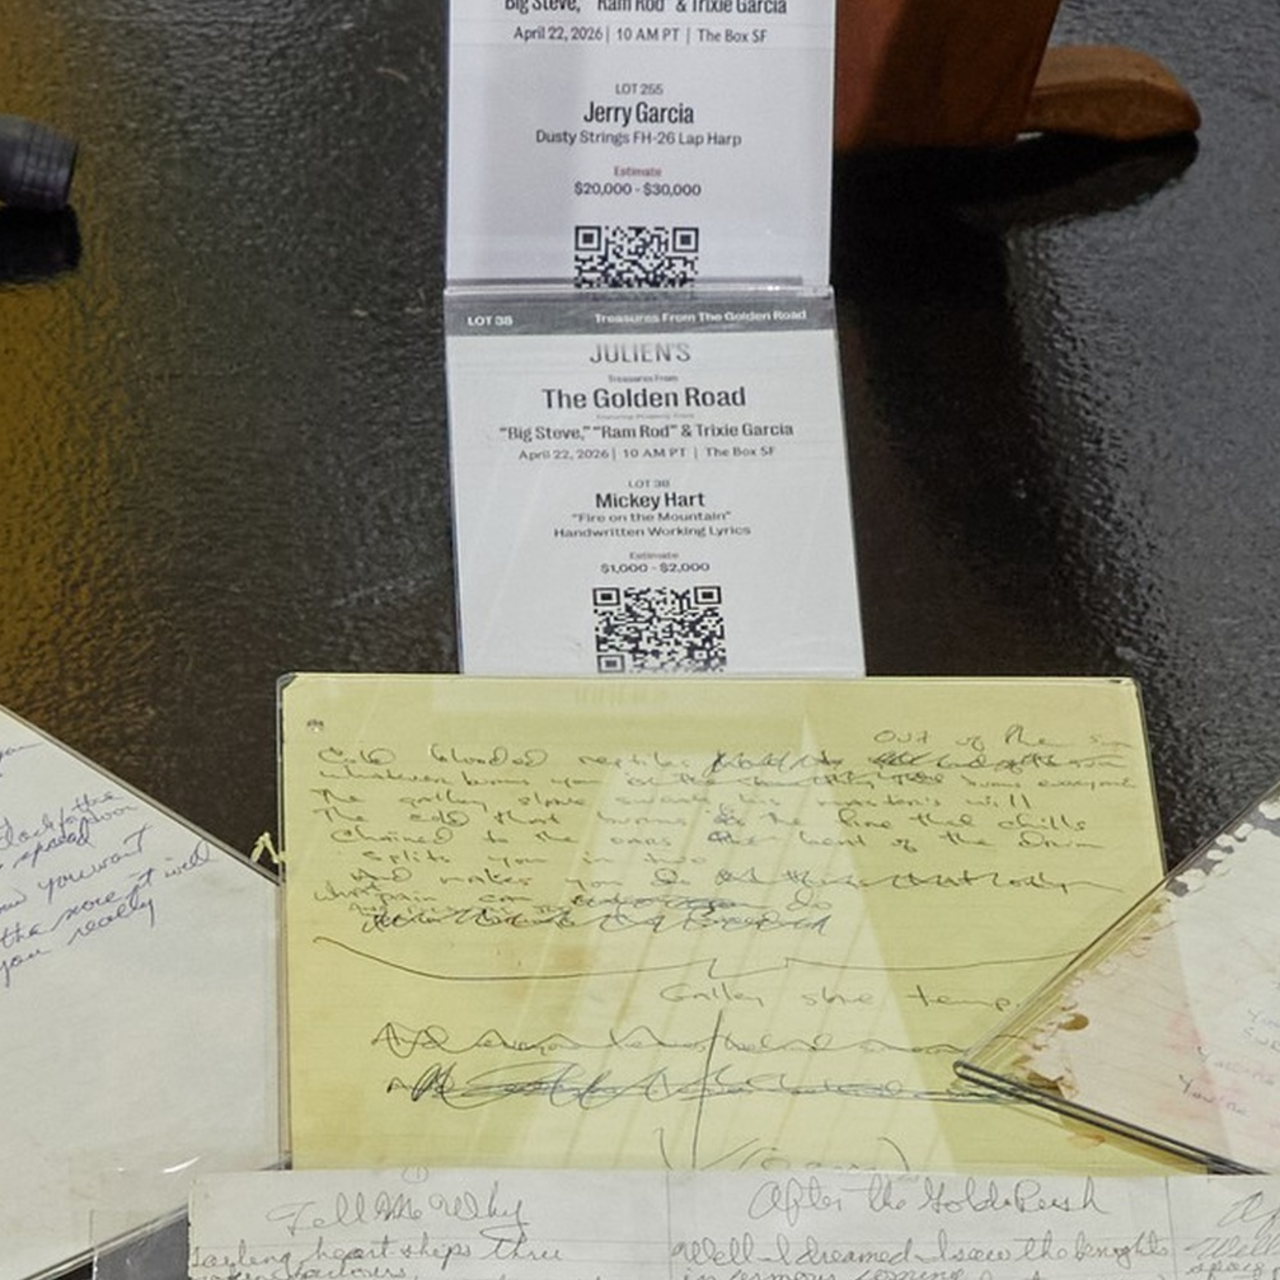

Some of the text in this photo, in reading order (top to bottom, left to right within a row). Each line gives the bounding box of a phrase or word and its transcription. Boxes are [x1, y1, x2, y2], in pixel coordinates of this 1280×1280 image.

[513, 25, 767, 43] April 22, 2026 10 AM PT The Box SF
[615, 82, 664, 95] LOT 255
[583, 100, 694, 128] Jerry Garcia
[535, 128, 742, 148] Dusty Strings FH-26 Lap Harp
[613, 165, 662, 177] Estimate
[574, 180, 633, 196] $20,000
[643, 182, 702, 197] $30,000
[594, 309, 807, 323] Treasures From The Golden Road
[589, 343, 691, 363] JULIEN'S
[542, 386, 746, 409] The Golden Road
[680, 423, 692, 437] &
[695, 423, 738, 437] Trixie
[741, 422, 794, 436] Garcia
[595, 491, 705, 511] Mickey Hart
[553, 526, 751, 537] Handwritten Working Lyrics
[600, 563, 648, 574] $1,000
[659, 562, 710, 573] $2,000
